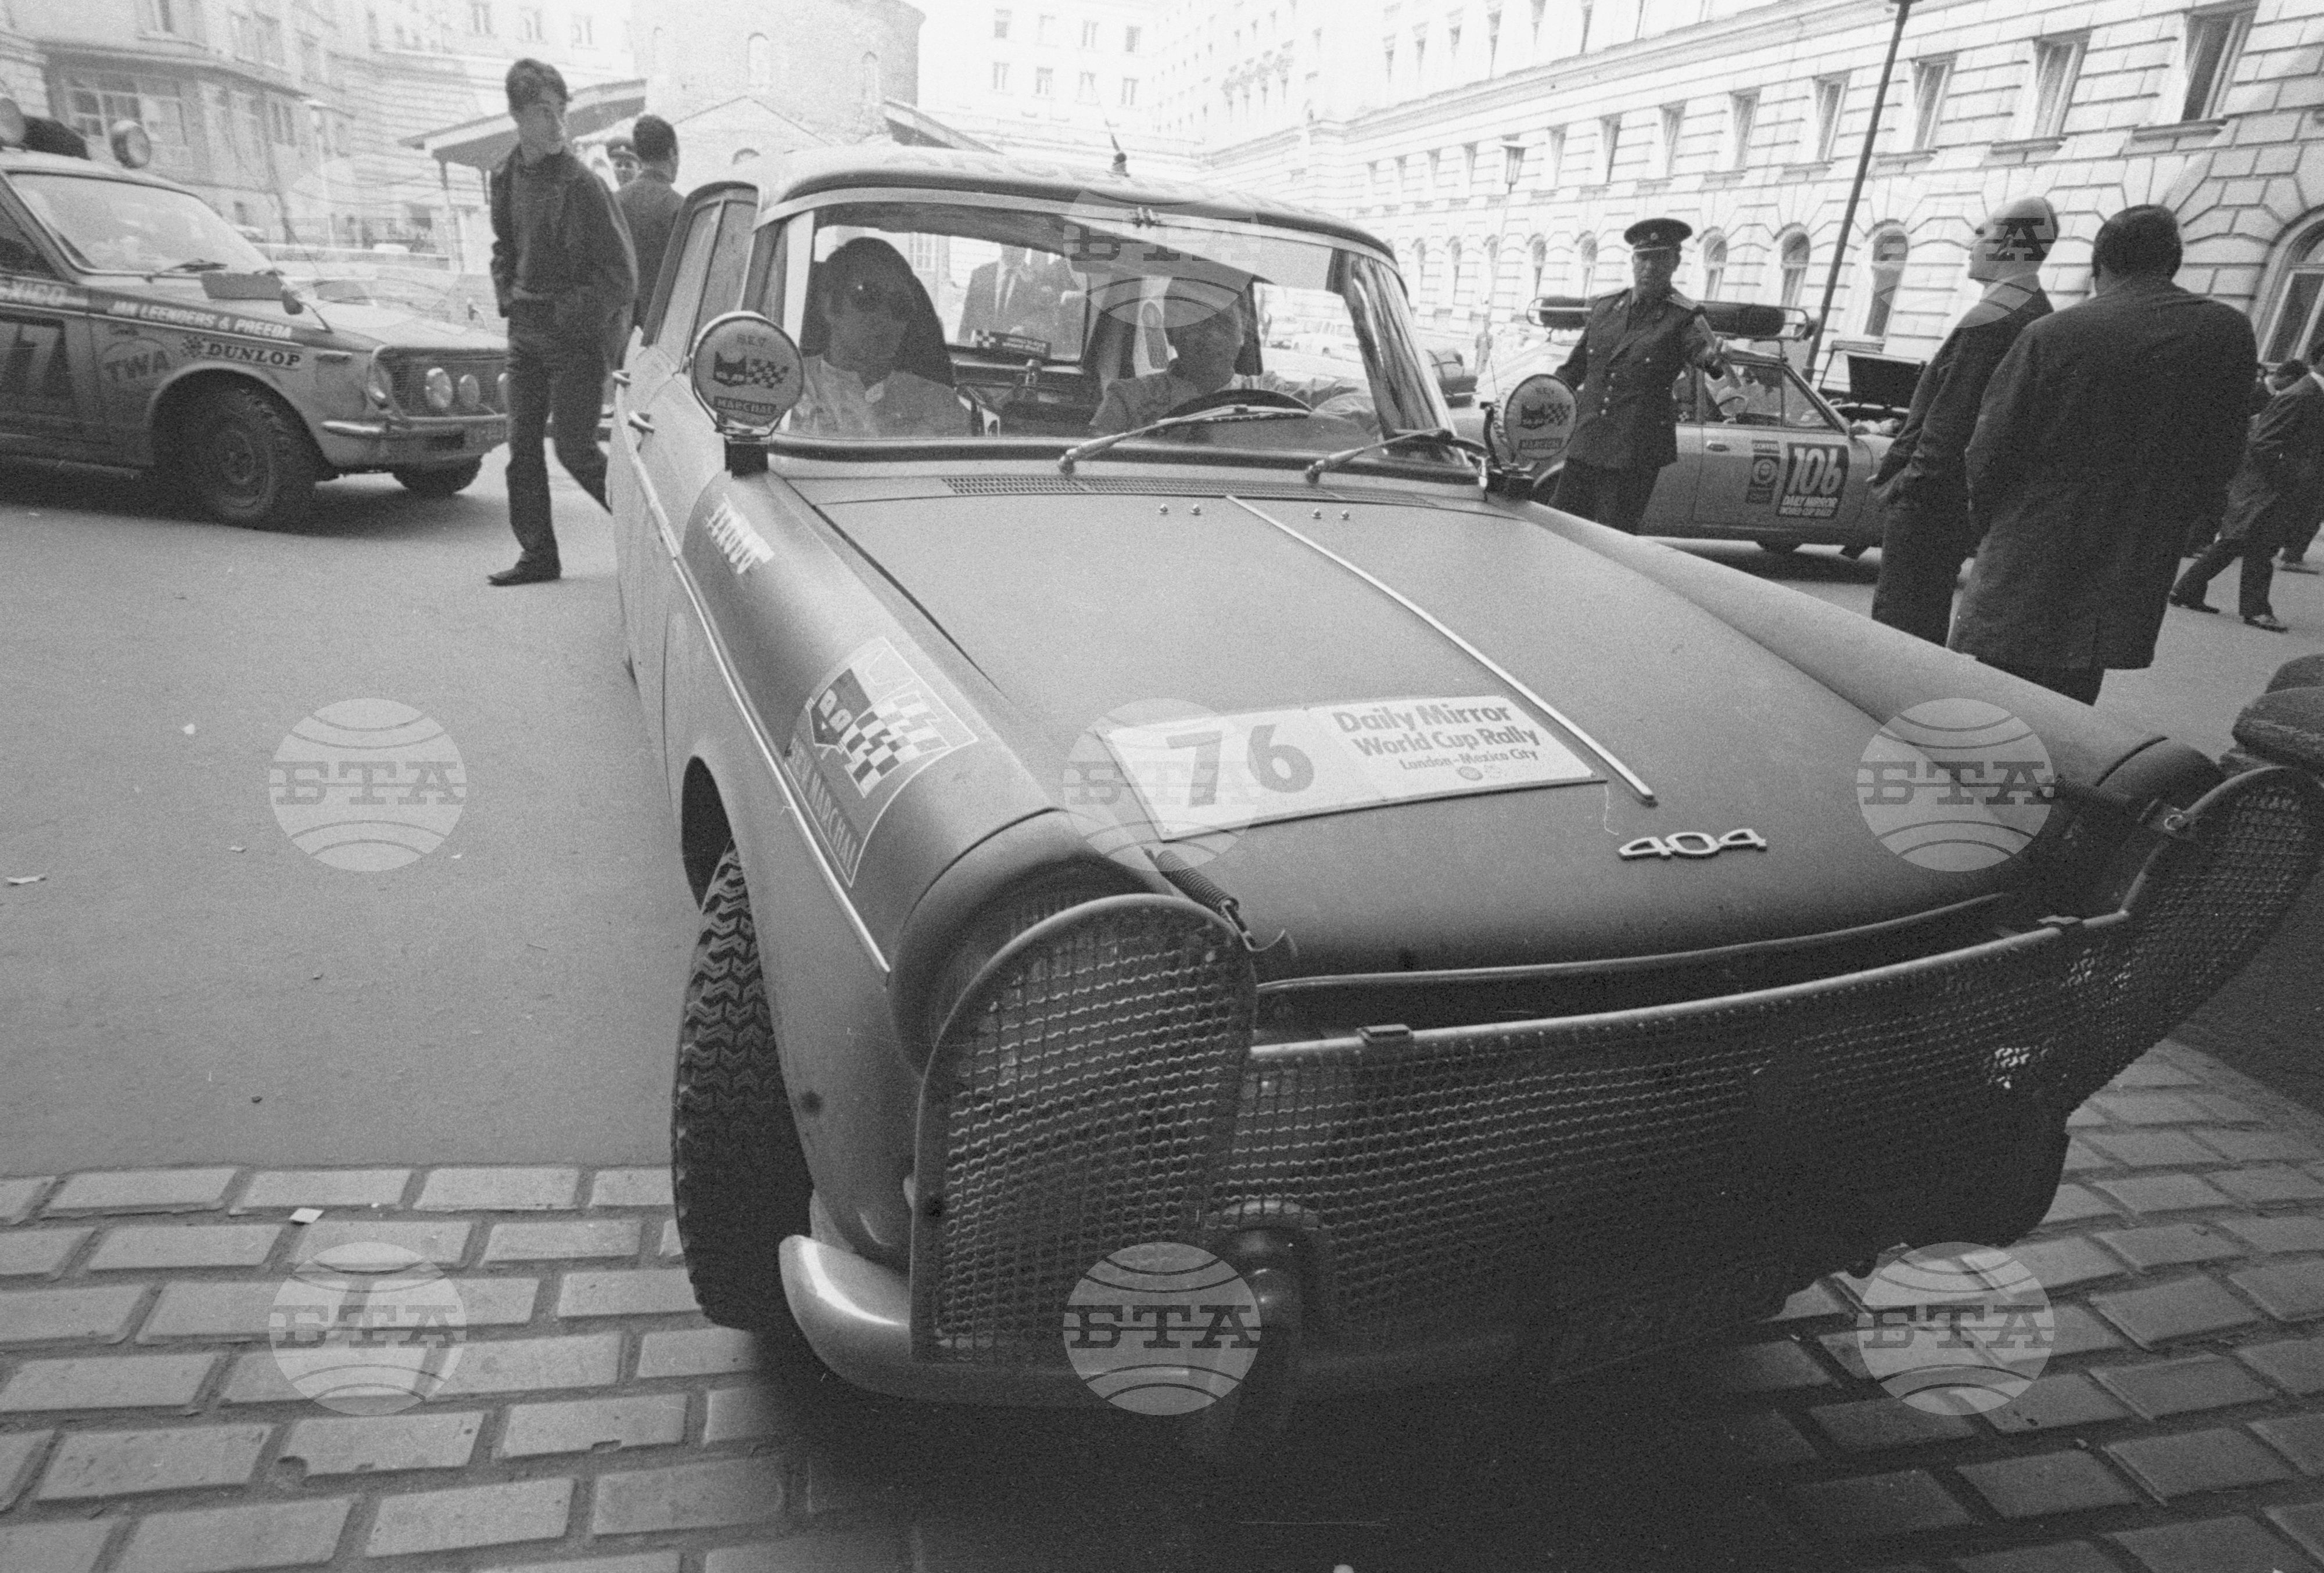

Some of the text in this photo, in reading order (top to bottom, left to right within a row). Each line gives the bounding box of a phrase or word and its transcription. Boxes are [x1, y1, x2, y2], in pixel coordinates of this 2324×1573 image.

[218, 316, 231, 330] &
[206, 342, 300, 367] DUNLOP
[717, 398, 773, 415] MARCHAL
[1787, 447, 1842, 494] 106
[1332, 703, 1512, 733] Daily Mirror
[1351, 726, 1541, 756] World Cup Rally
[1510, 748, 1540, 762] City
[1165, 724, 1314, 808] 76
[1619, 828, 1766, 856] 404
